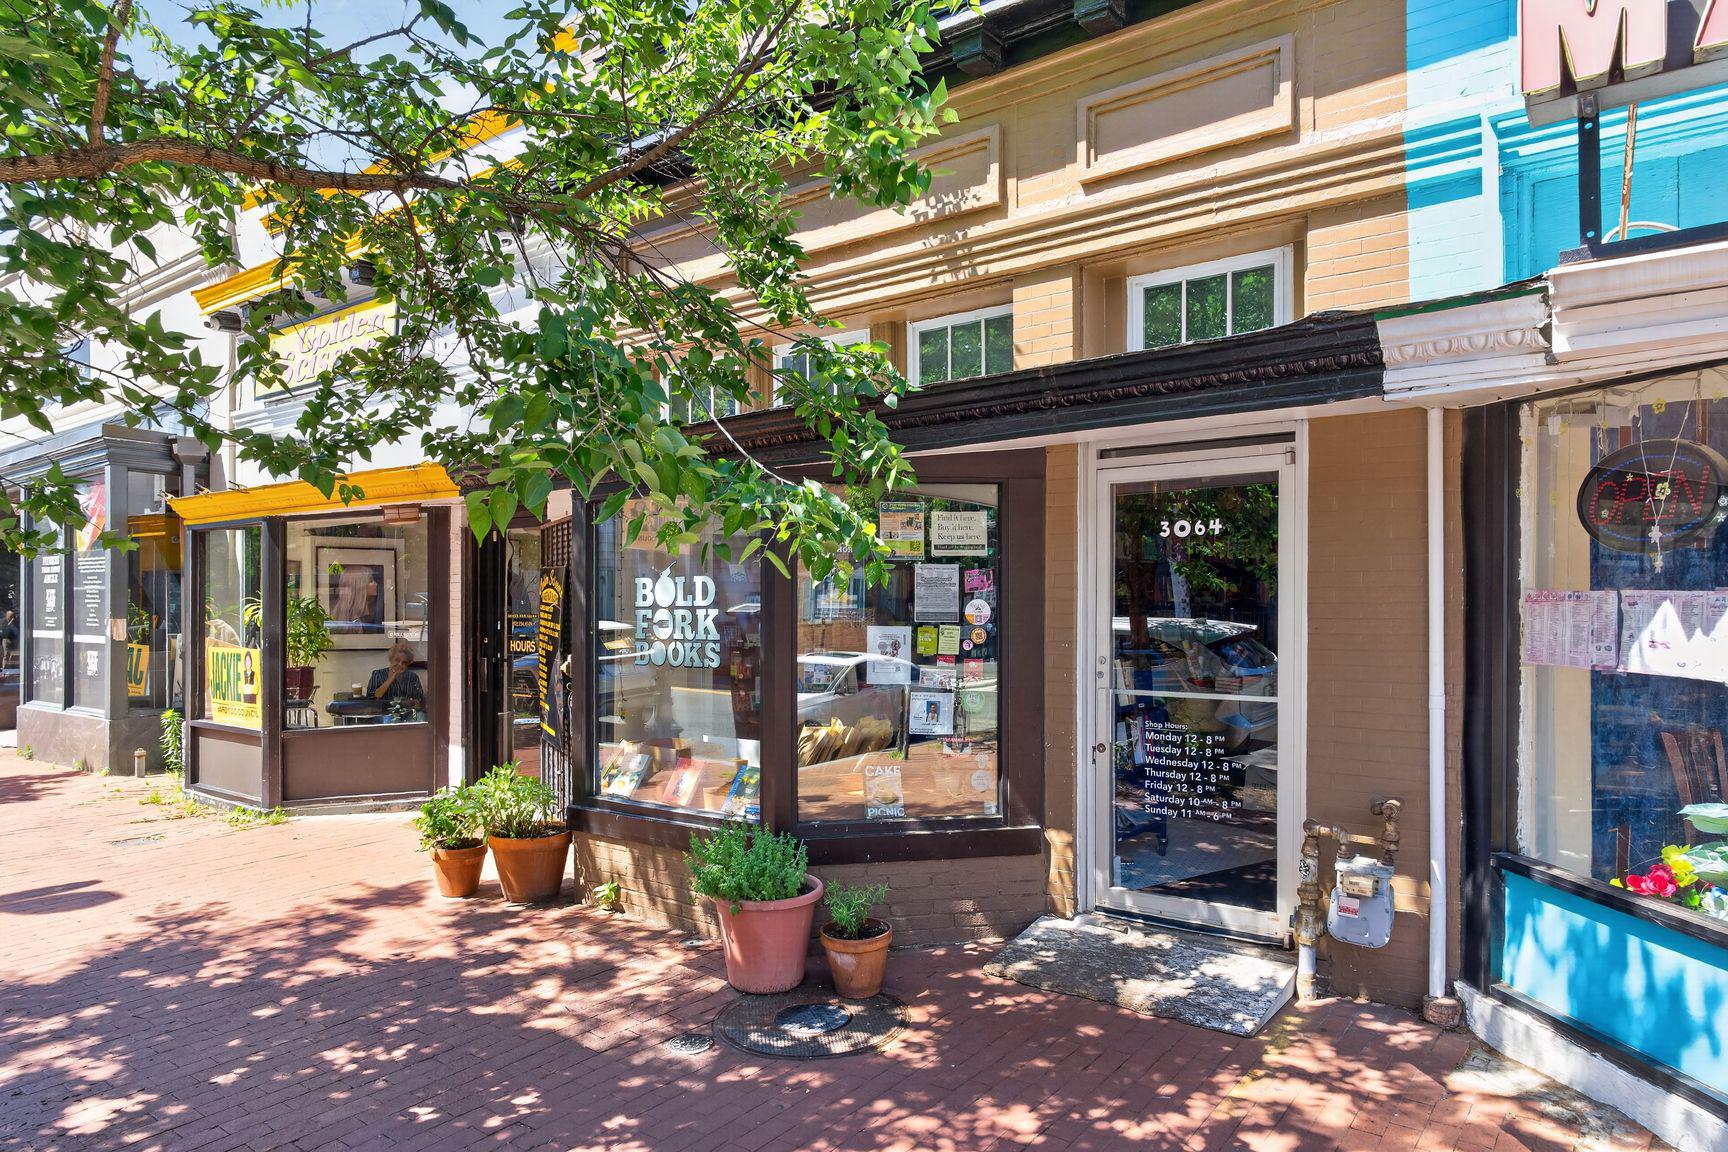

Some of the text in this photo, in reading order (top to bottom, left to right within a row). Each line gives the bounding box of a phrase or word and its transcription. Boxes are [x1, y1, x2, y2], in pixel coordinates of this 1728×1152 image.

[1517, 0, 1728, 95] M
[298, 311, 385, 354] Golden
[1589, 464, 1711, 526] OPEN
[937, 514, 952, 522] Find
[959, 514, 976, 522] here.
[937, 524, 950, 532] Buy
[1160, 518, 1222, 538] 3064
[937, 533, 955, 542] Keep
[965, 532, 982, 540] here.
[634, 574, 716, 609] BOLD
[634, 608, 721, 641] FORK
[510, 640, 536, 652] HOURS
[634, 640, 721, 669] BOOKS
[210, 651, 242, 702] JACKIE
[1145, 720, 1188, 730] Shop Hours:
[1145, 731, 1182, 744] Monday
[1185, 734, 1197, 742] 12
[1206, 736, 1212, 744] 8
[1145, 743, 1181, 756] Tuesday
[1185, 747, 1196, 755] 12
[1205, 748, 1212, 757] 8
[1145, 756, 1199, 770] Wednesday
[1201, 761, 1214, 770] 12
[1223, 762, 1229, 771] 8
[864, 766, 901, 776] CAKE
[1145, 768, 1186, 781] Thursday
[1190, 773, 1201, 781] 12
[1210, 774, 1216, 782] 8
[1145, 780, 1173, 792] Friday
[1176, 784, 1187, 792] 12
[1197, 785, 1203, 793] 8
[1145, 792, 1185, 806] Saturday
[1189, 798, 1200, 806] 10
[1222, 801, 1228, 809] 8
[868, 808, 905, 816] PICNIC
[1145, 804, 1178, 818] Sunday
[1181, 809, 1192, 818] 11
[1213, 812, 1219, 820] 6
